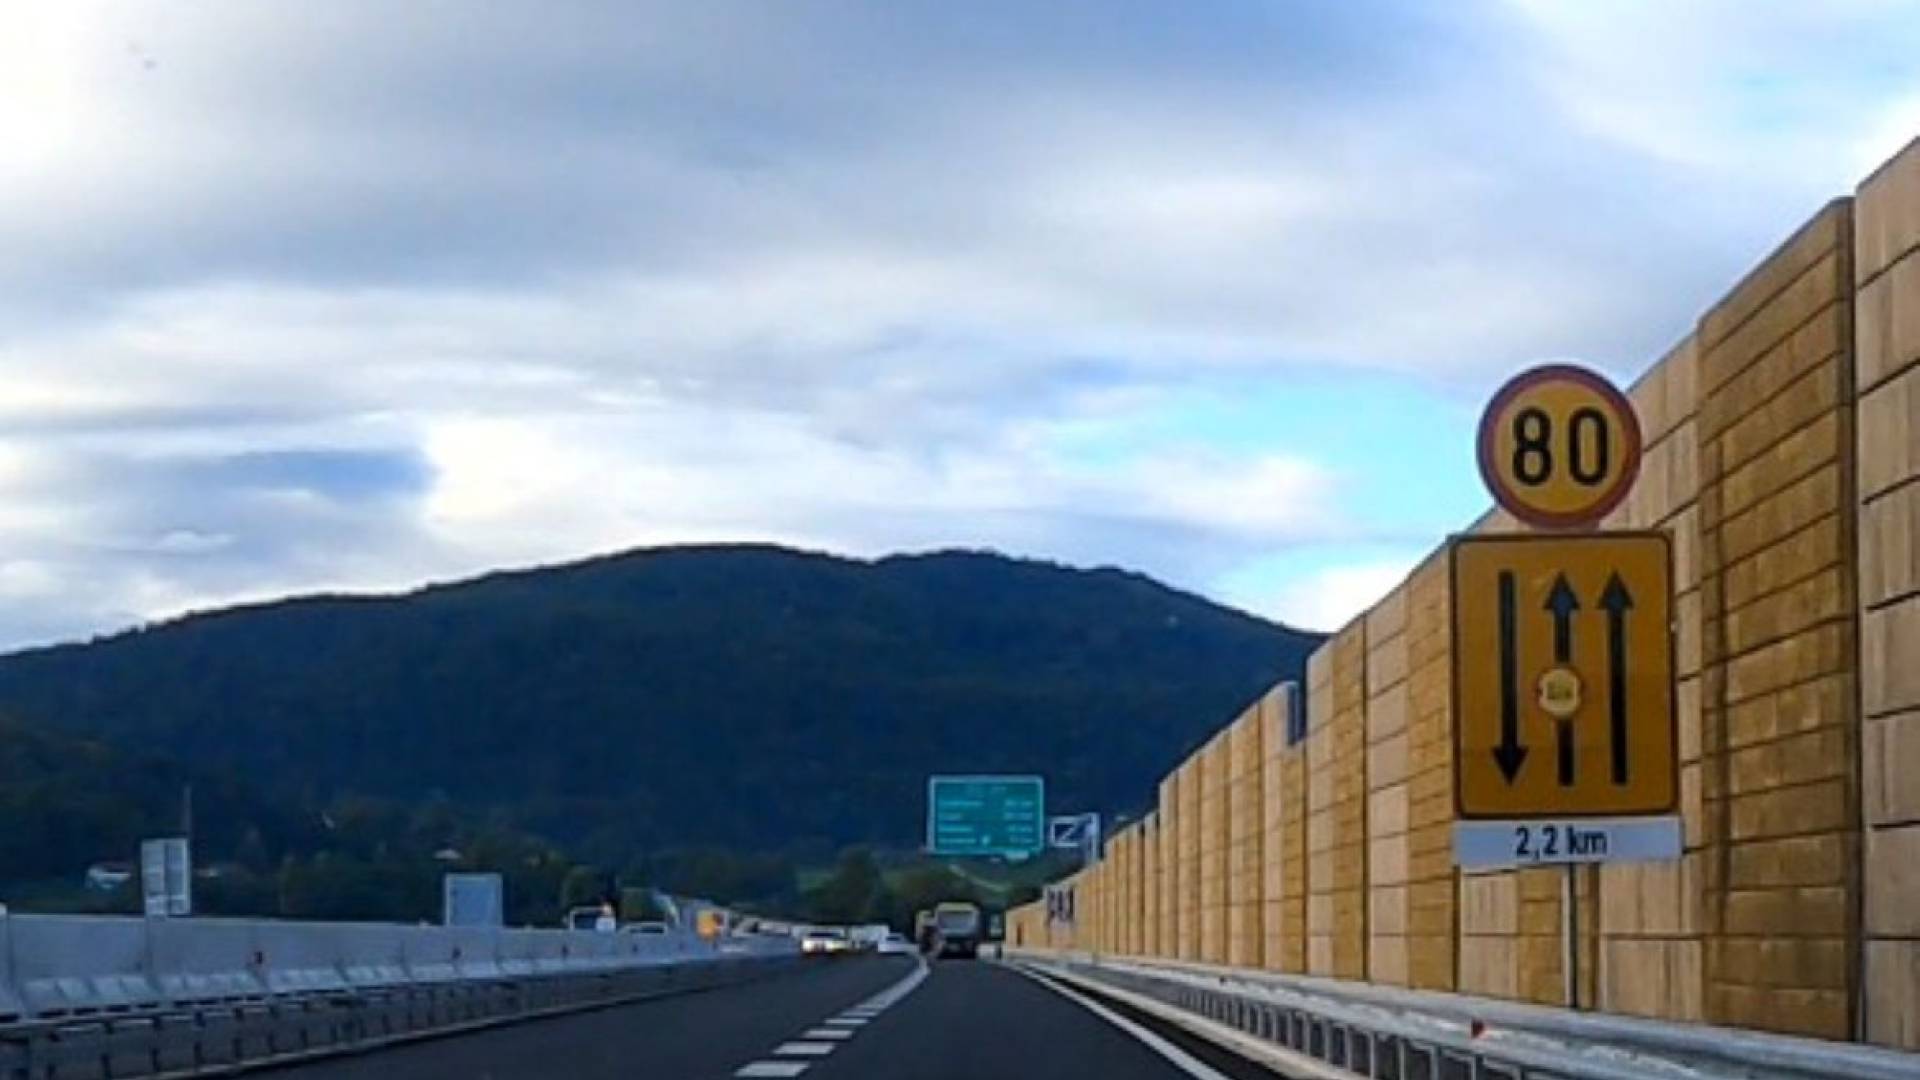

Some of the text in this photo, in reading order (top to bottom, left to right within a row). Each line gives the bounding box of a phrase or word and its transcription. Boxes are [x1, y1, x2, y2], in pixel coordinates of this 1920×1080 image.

[1512, 407, 1609, 487] 80
[1515, 825, 1607, 860] 2,2 km
